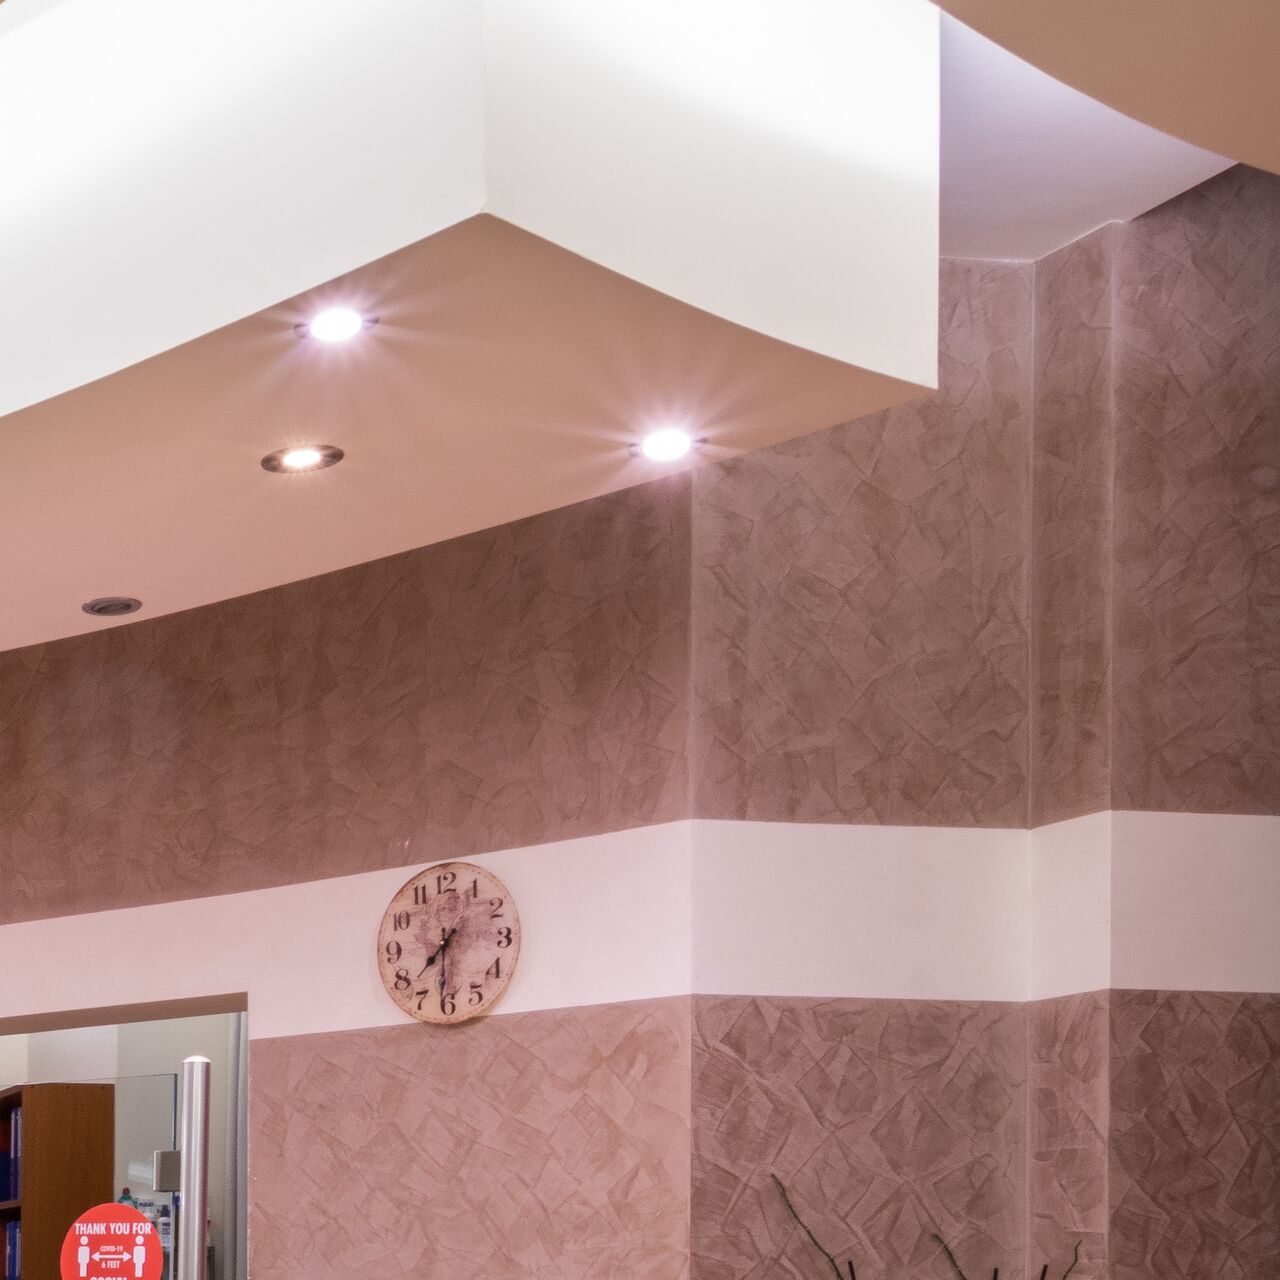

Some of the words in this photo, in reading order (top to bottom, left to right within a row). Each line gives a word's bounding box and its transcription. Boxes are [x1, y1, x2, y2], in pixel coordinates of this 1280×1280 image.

[435, 871, 458, 895] 12
[470, 878, 479, 899] 1
[413, 885, 428, 906] 11
[489, 896, 504, 920] 2
[393, 910, 412, 932] 10
[497, 926, 513, 949] 3
[385, 940, 403, 965] 9
[393, 967, 412, 991] 8
[485, 956, 501, 979] 4
[415, 989, 429, 1011] 7
[441, 993, 456, 1016] 6
[468, 983, 484, 1006] 5
[75, 1222, 107, 1235] THANK
[109, 1222, 130, 1235] YOU
[132, 1222, 152, 1235] FOR
[101, 1260, 106, 1269] 6
[107, 1260, 121, 1269] FEET
